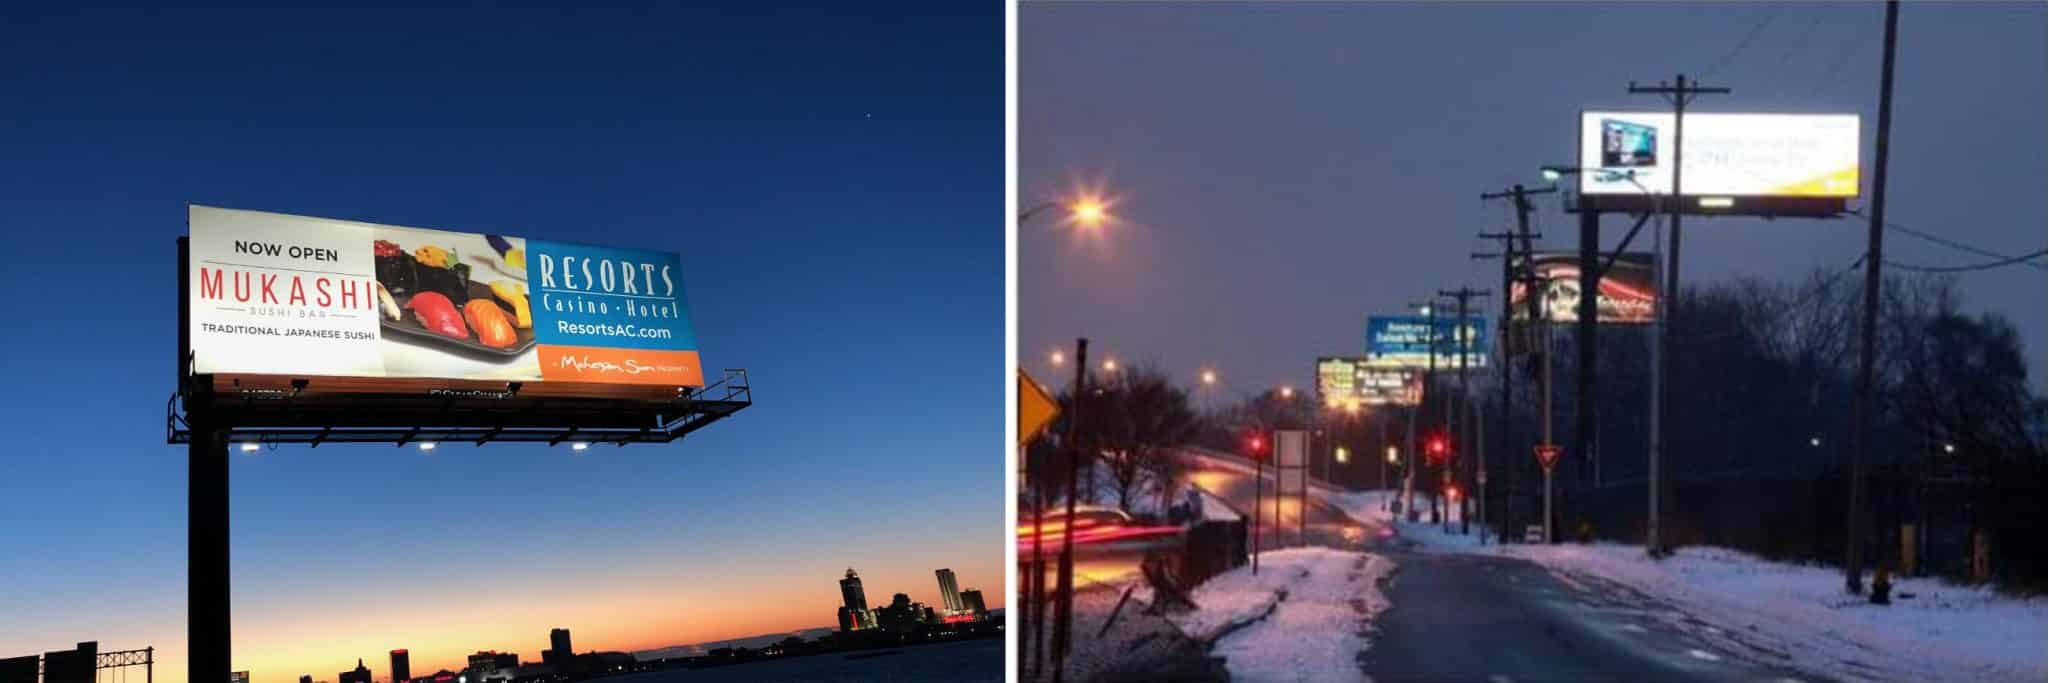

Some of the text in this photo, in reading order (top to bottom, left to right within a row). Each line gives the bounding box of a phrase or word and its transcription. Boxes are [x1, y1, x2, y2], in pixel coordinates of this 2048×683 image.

[235, 240, 338, 262] NOW OPEN
[539, 254, 673, 296] RESORTS
[201, 267, 372, 310] MUKASHI
[250, 306, 327, 318] SUSHI BAR
[543, 293, 678, 318] Casino Hotel
[201, 323, 375, 340] TRADITIONAL JAPANESE SUSHI
[558, 320, 672, 339] ResortsAC.com
